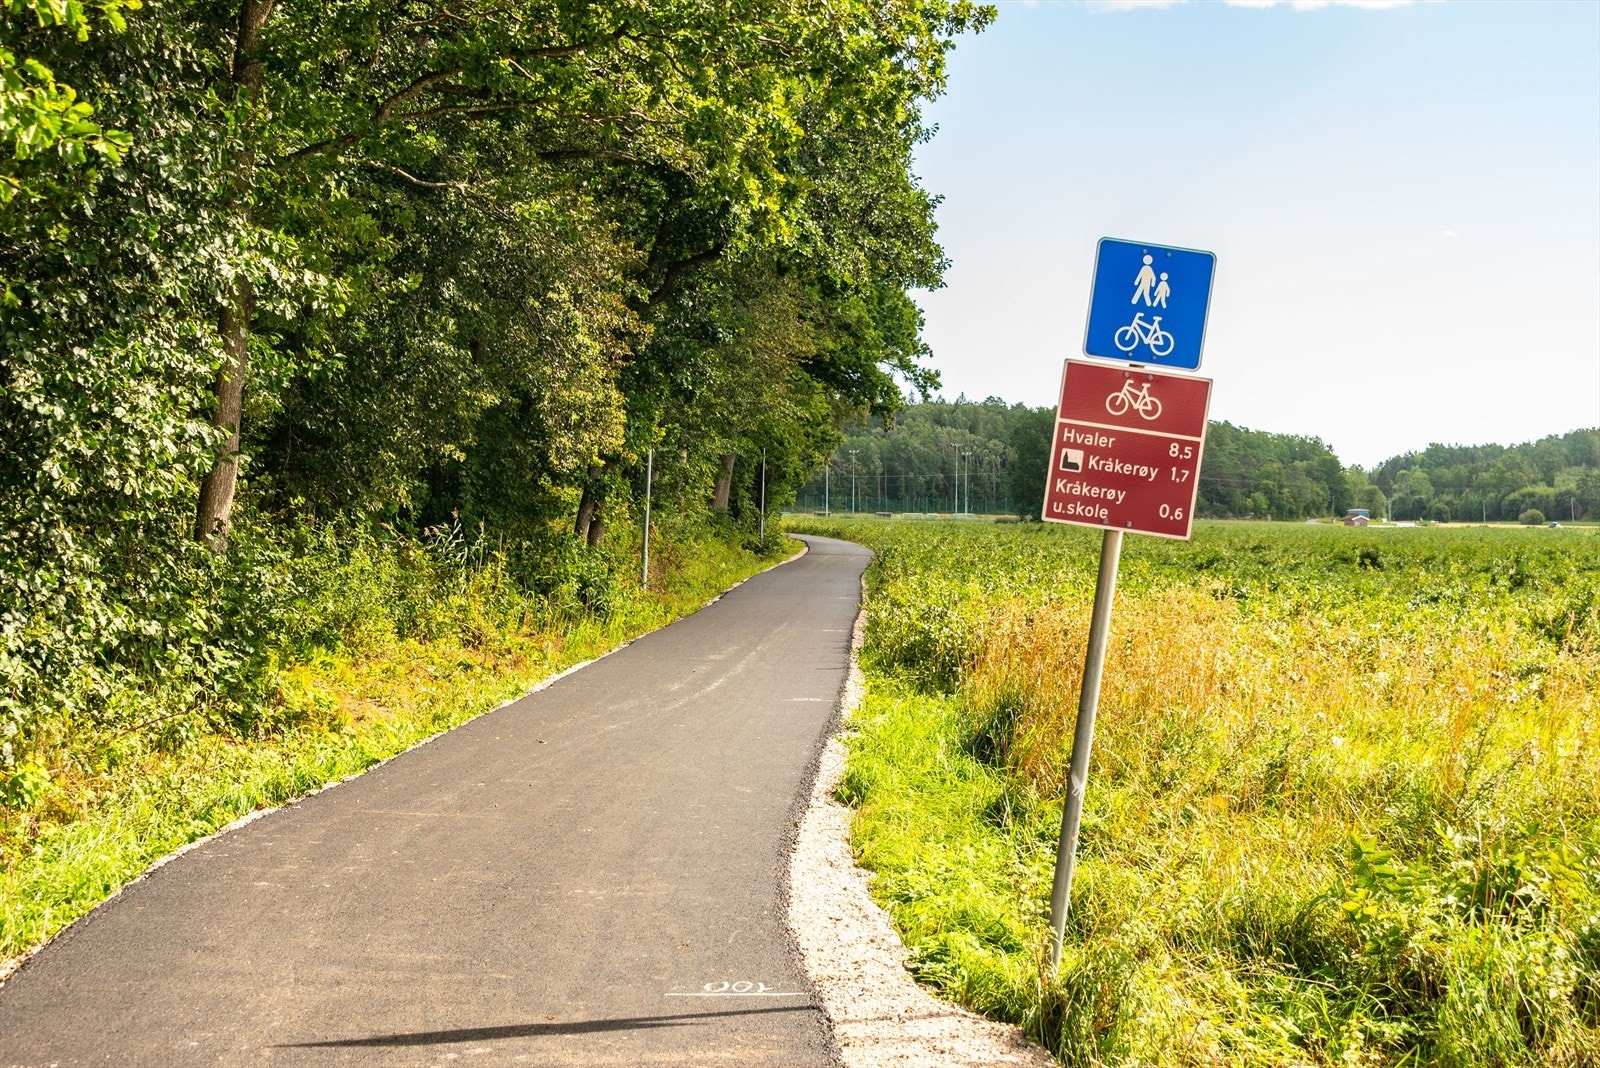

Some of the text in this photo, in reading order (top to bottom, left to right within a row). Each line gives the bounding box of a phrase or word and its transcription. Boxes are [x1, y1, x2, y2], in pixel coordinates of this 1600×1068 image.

[1063, 428, 1192, 459] Hvaler 8,5
[1088, 455, 1189, 482] Kråkerøy 1,7
[1055, 478, 1126, 504] Kråkerøy
[1053, 501, 1183, 520] u.skole 0,6
